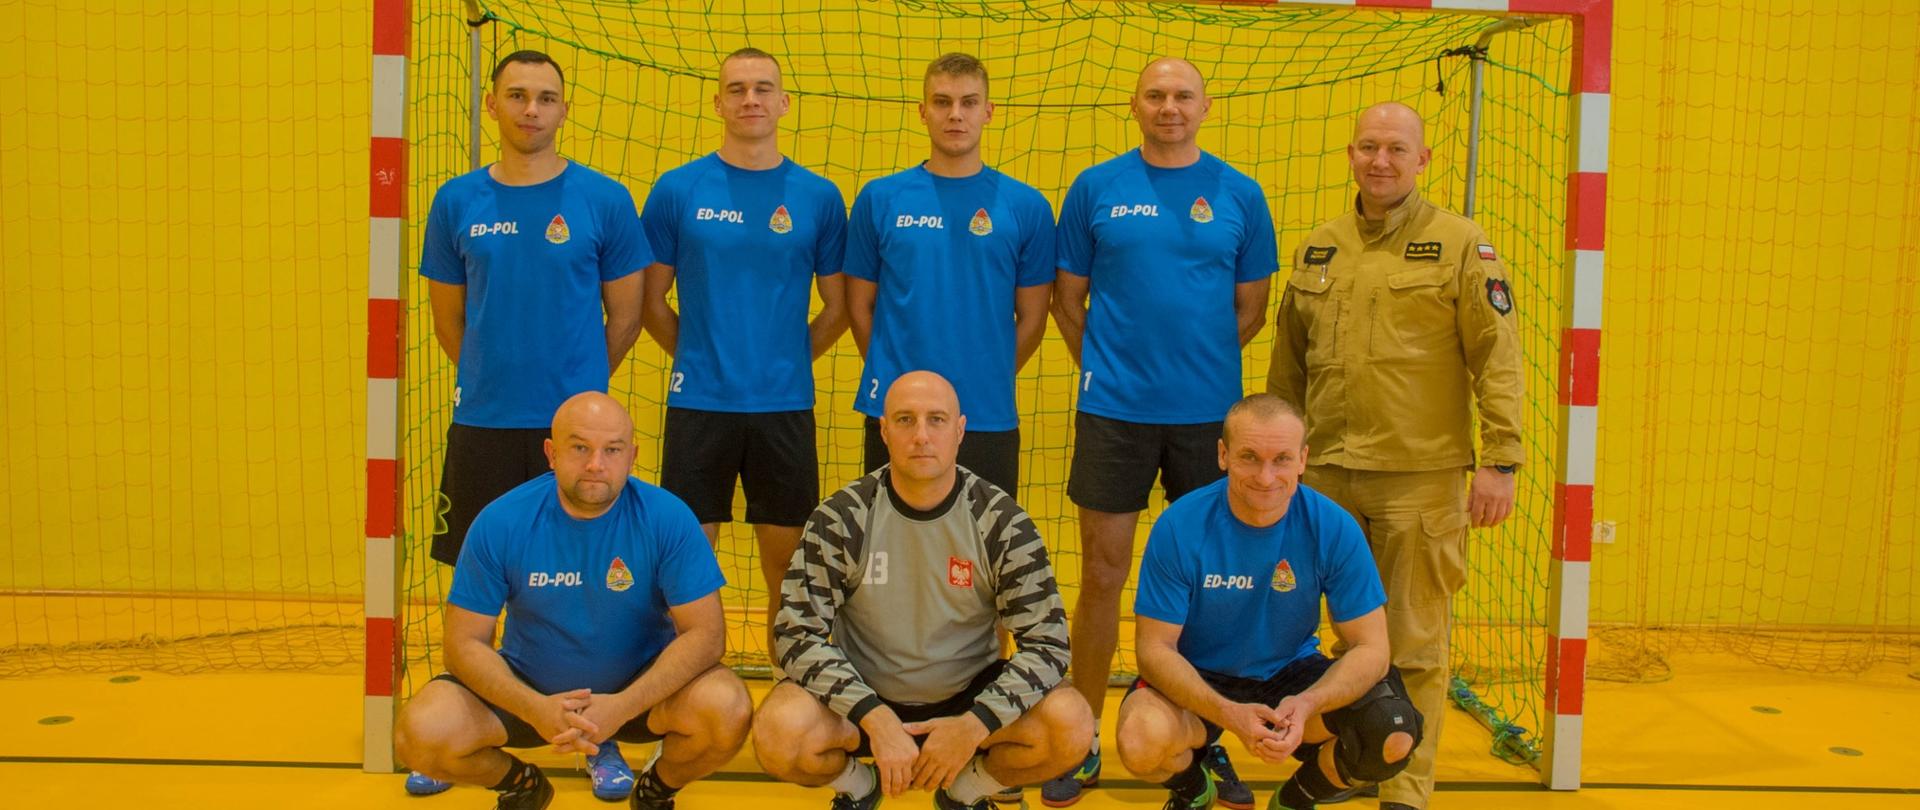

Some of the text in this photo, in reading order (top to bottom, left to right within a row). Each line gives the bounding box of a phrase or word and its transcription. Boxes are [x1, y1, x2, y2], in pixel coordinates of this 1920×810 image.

[696, 208, 744, 223] ED-POL
[1110, 204, 1159, 218] ED-POL
[470, 221, 519, 237] ED-POL
[896, 215, 944, 229] ED-POL
[870, 378, 879, 399] 2
[861, 551, 888, 584] 13
[528, 572, 583, 587] ED-POL
[1203, 574, 1254, 589] ED-POL
